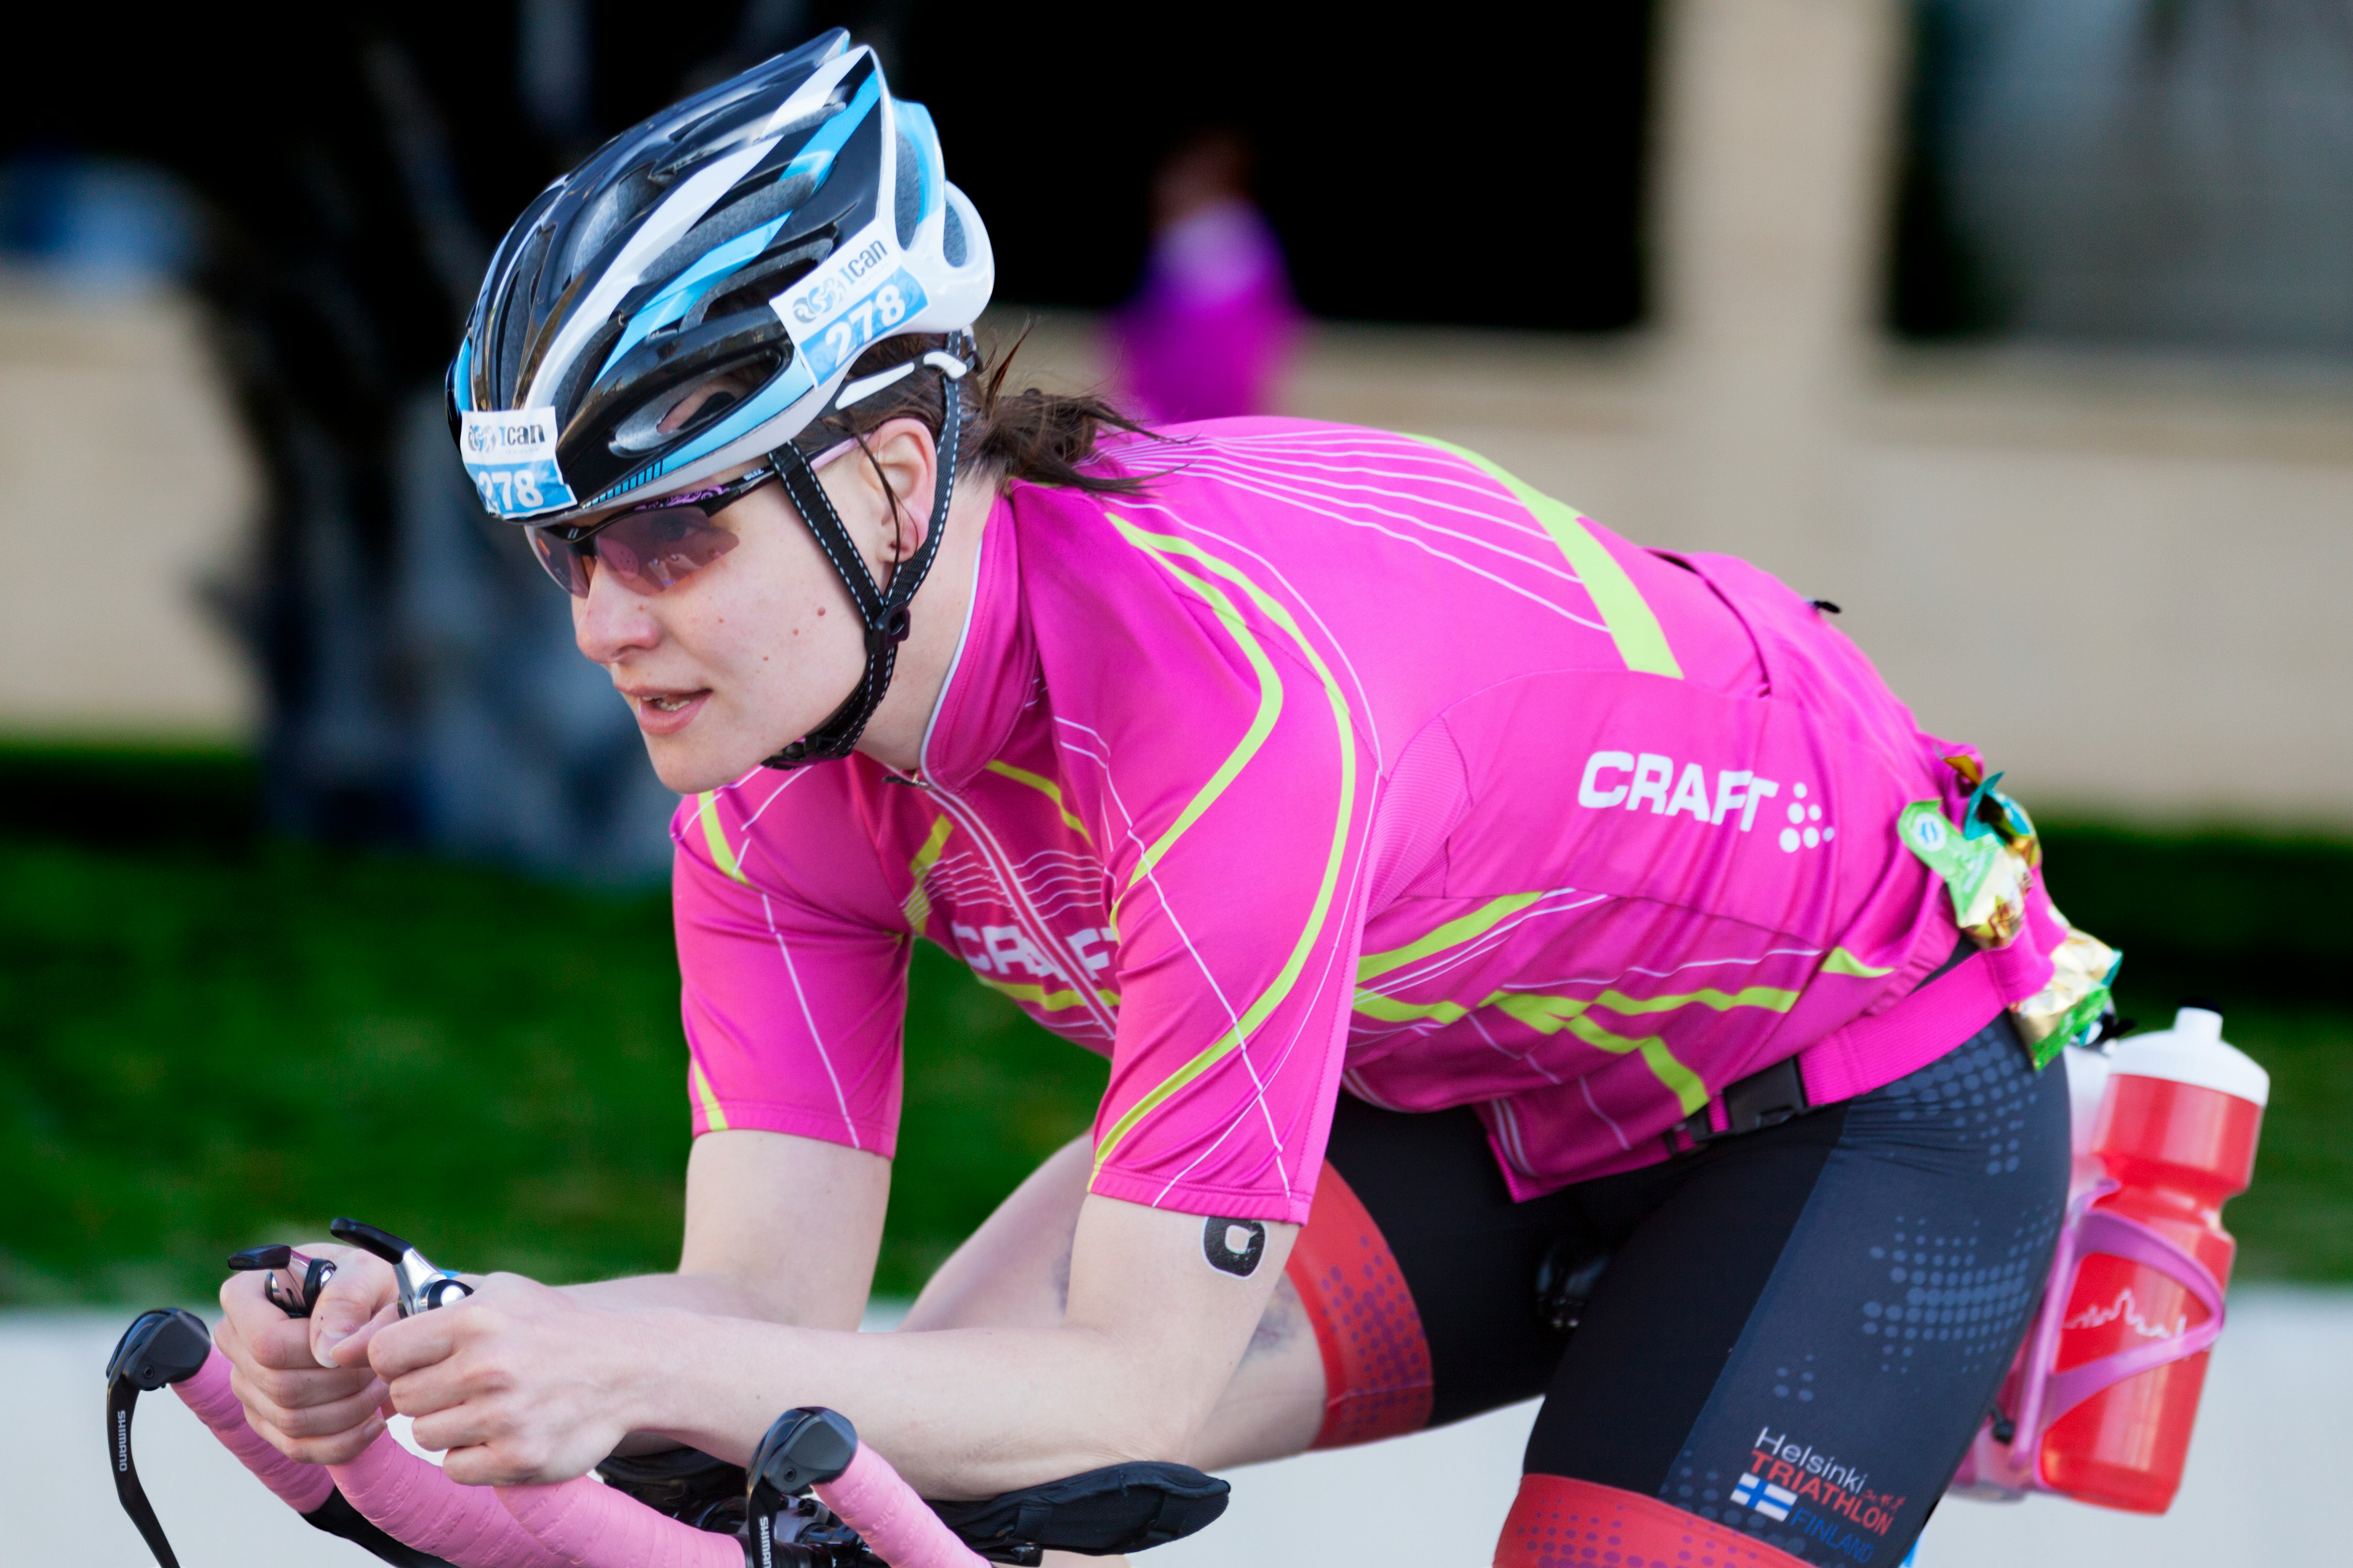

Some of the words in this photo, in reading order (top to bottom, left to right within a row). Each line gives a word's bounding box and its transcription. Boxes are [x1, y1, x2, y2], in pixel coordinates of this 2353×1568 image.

[826, 284, 905, 368] 278
[478, 470, 544, 512] 278
[1578, 751, 1780, 832] CRAFT
[117, 1410, 127, 1472] SHIMANO
[1754, 1426, 1868, 1495] Helsinki
[1751, 1450, 1894, 1536] TRIATHLON
[760, 1516, 772, 1568] SHIMAN
[1789, 1508, 1875, 1563] FINLAND
